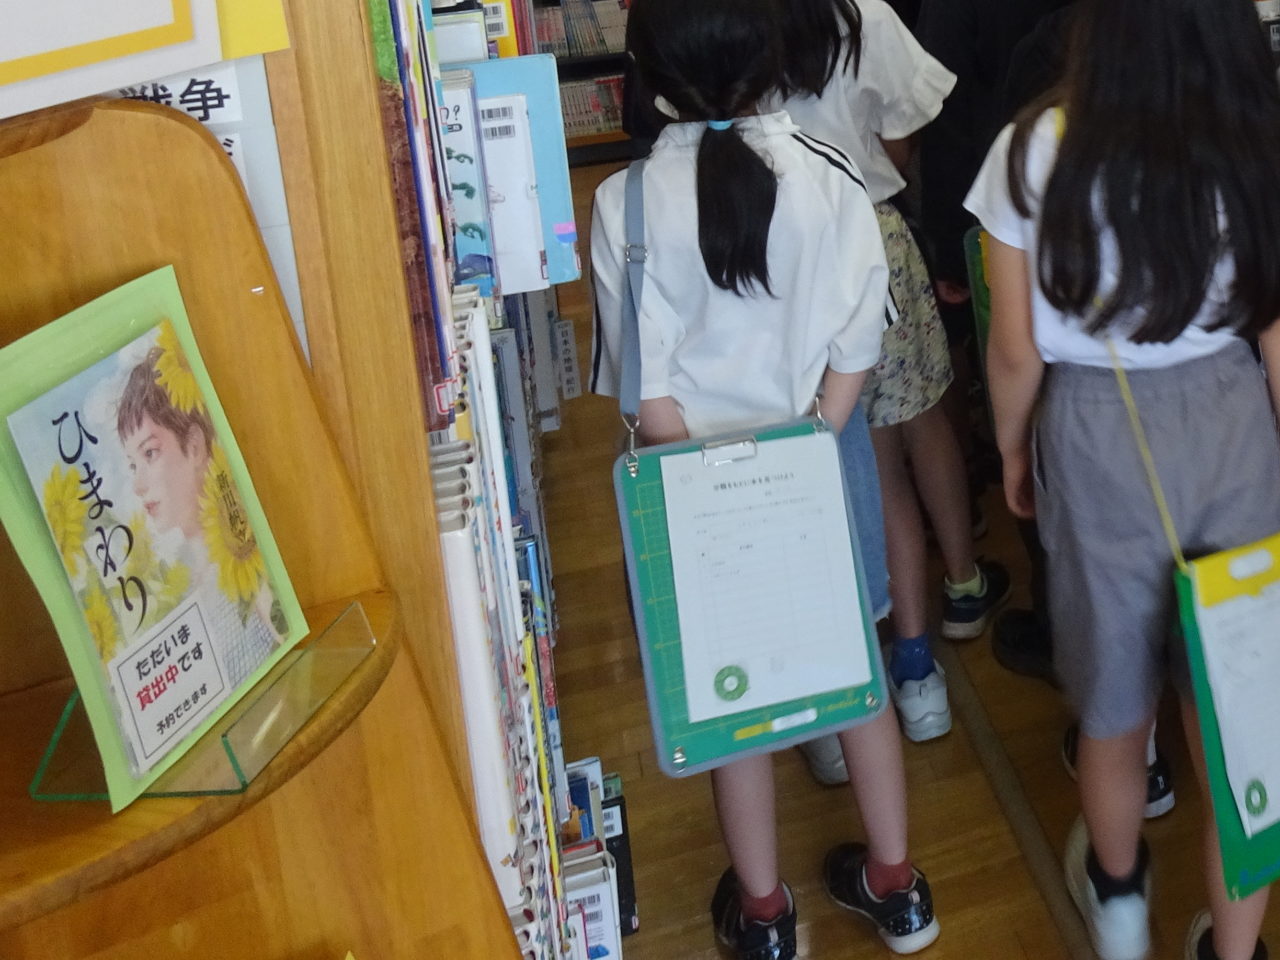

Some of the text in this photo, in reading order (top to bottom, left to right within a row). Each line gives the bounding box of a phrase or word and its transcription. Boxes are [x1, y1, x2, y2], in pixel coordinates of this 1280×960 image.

[51, 409, 149, 634] ひまわり
[135, 623, 193, 682] ただいま
[135, 642, 206, 712] 貸出中です
[155, 682, 210, 737] 予約できます
